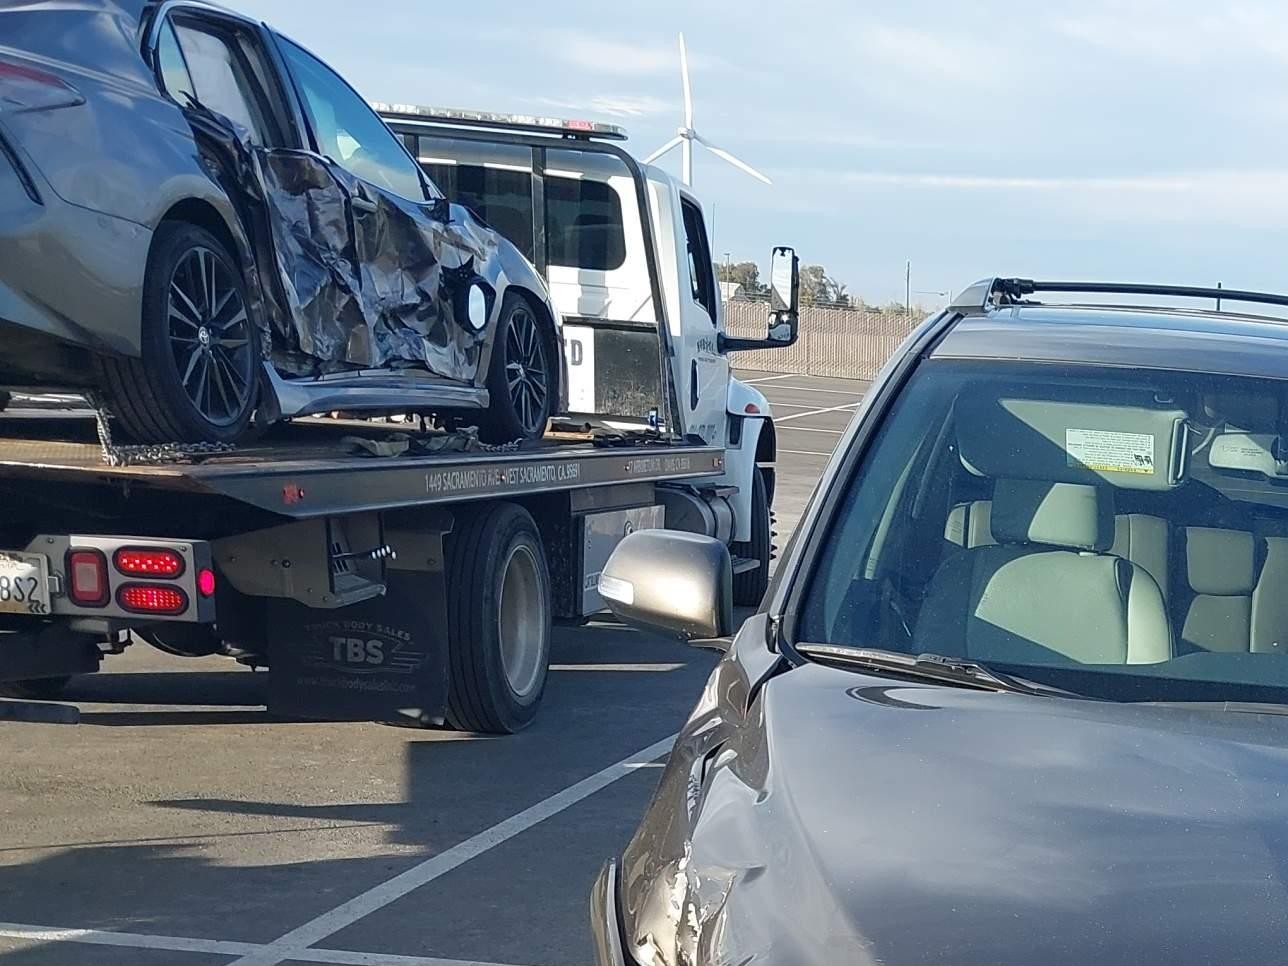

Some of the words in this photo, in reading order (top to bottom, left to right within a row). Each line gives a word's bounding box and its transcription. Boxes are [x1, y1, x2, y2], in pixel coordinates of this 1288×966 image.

[442, 470, 488, 491] SACRAMENTO
[504, 467, 520, 485] WEST
[376, 624, 412, 641] SALES
[328, 636, 384, 664] TBS
